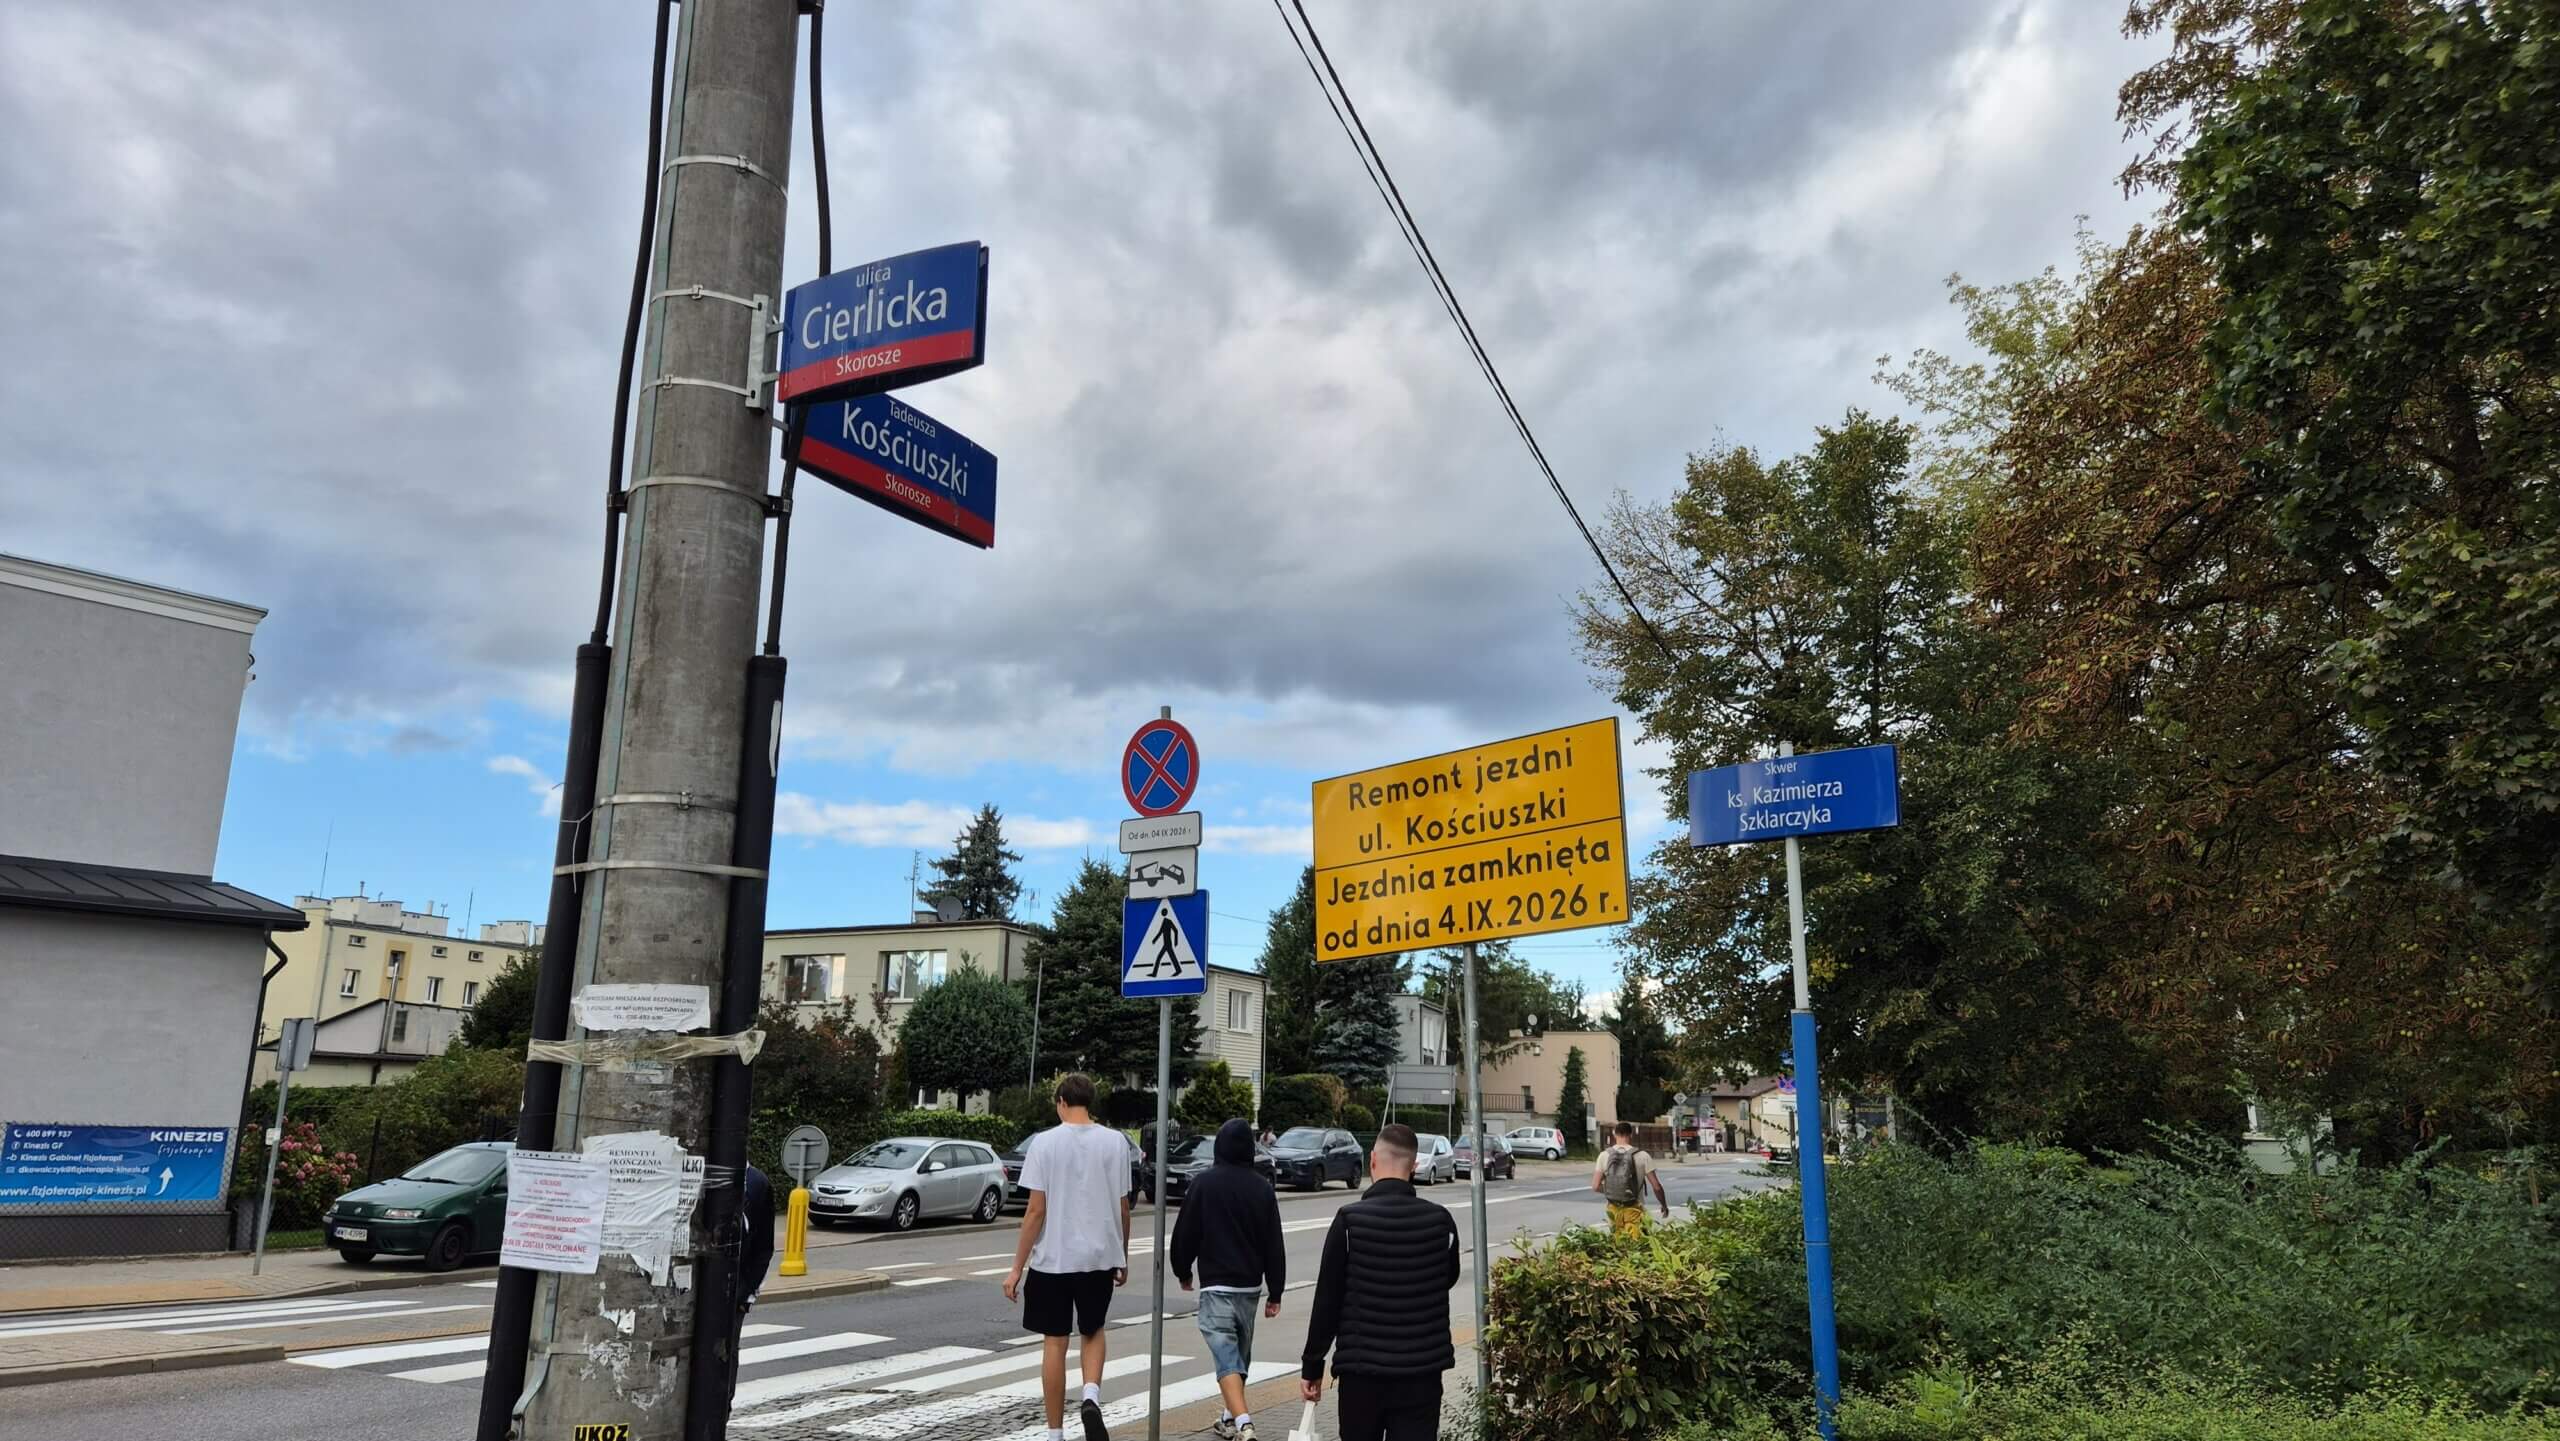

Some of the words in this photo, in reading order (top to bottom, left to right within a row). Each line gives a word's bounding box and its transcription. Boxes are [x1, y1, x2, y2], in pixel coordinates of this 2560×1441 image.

[856, 265, 891, 288] ulica
[802, 279, 947, 349] Cierlicka
[835, 347, 901, 376] Skorosze
[889, 400, 936, 438] Tadeusza
[842, 402, 968, 496] Kościuszki
[885, 473, 931, 508] Skorosze
[1349, 761, 1462, 811] Remont
[1474, 737, 1572, 794] jezdni
[1765, 760, 1797, 776] Skwer
[1728, 790, 1747, 808] ks.
[1753, 780, 1843, 805] Kazimierza
[1359, 822, 1392, 854] ul.
[1407, 788, 1566, 845] Kościuszki
[1739, 804, 1831, 832] Szklarczyka
[1128, 832, 1138, 840] Od
[1327, 864, 1435, 906] Jezdnia
[1444, 836, 1610, 887] zamknięta
[1324, 919, 1358, 952] od
[1367, 912, 1430, 946] dnia
[1438, 884, 1588, 934] 4.IX.2026
[1600, 891, 1619, 914] r.
[150, 1131, 224, 1142] KINEZIS
[20, 1154, 48, 1162] Kinezis
[48, 1153, 82, 1162] Gabinet
[0, 1185, 147, 1198] www.fizjoterapia-kinezis.pl
